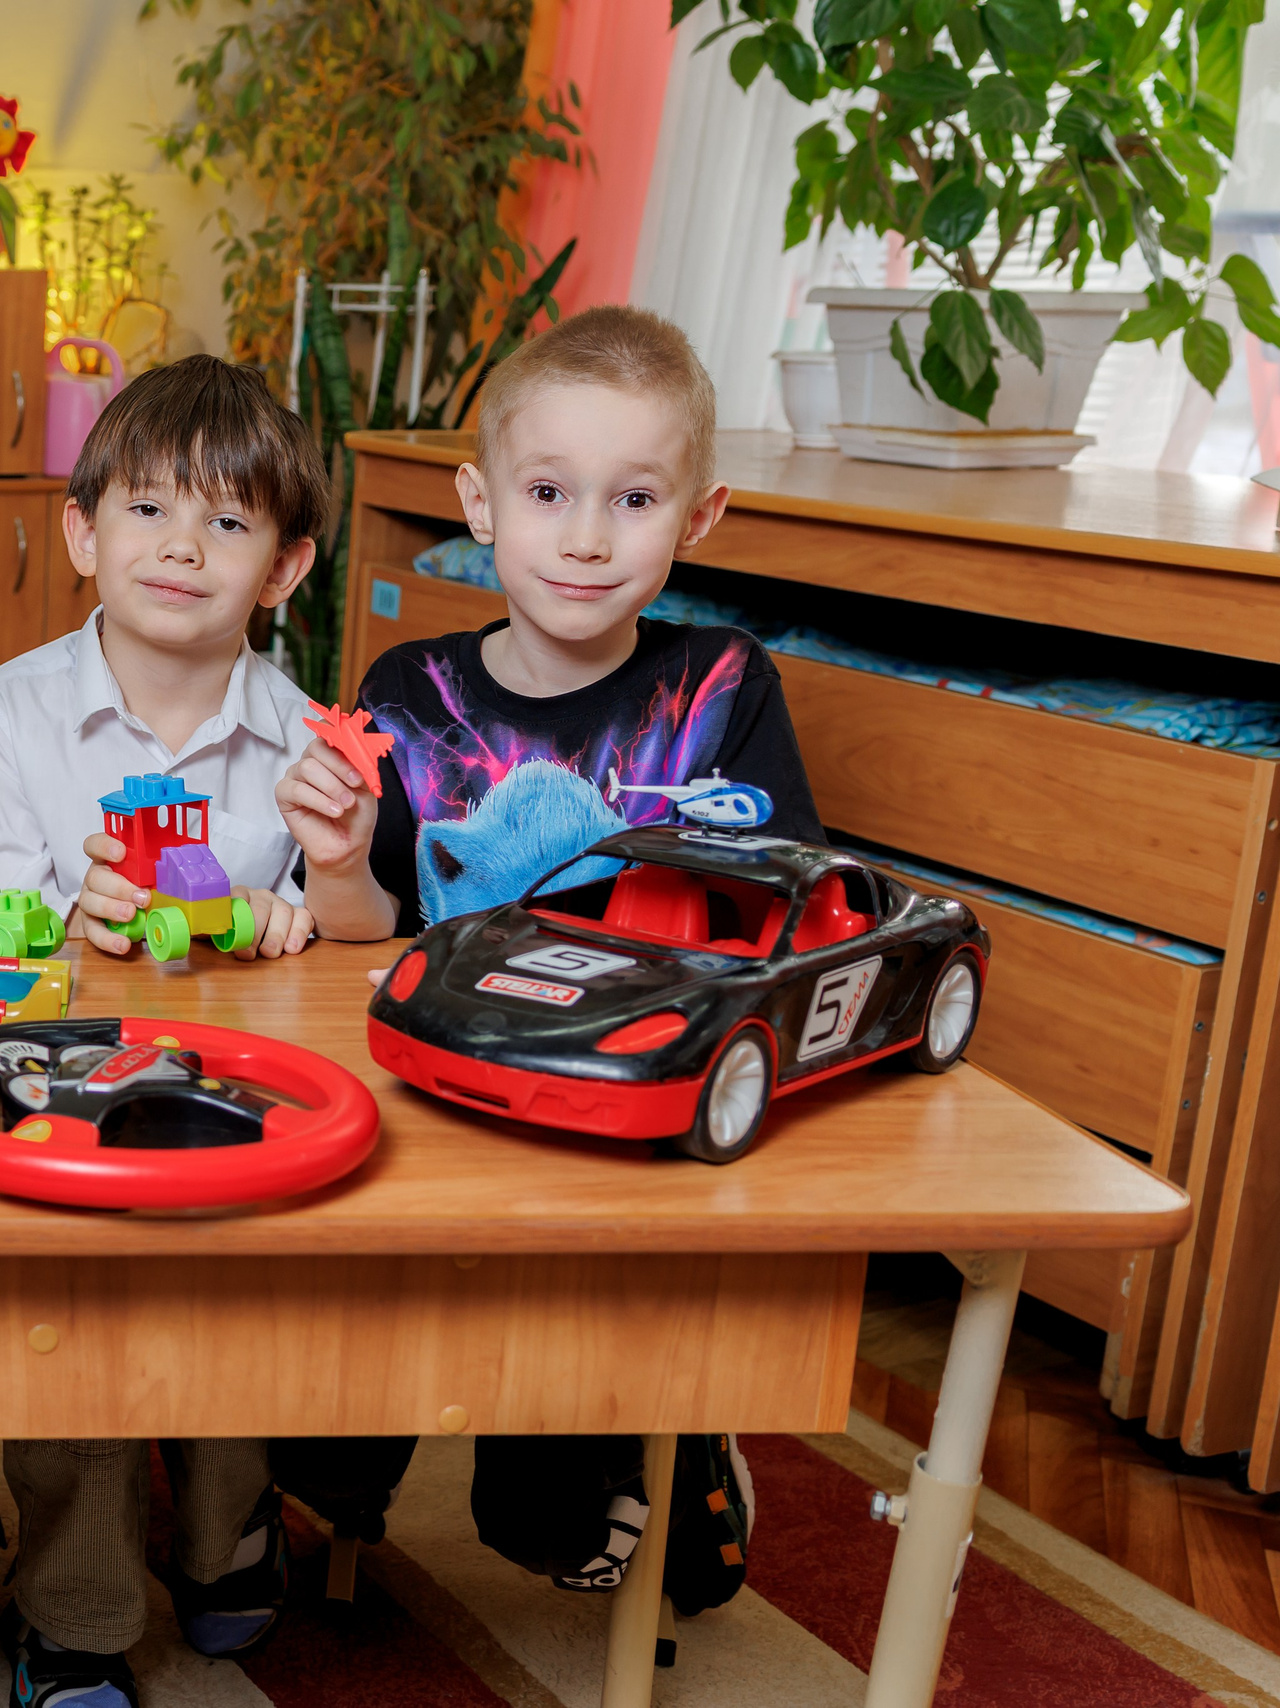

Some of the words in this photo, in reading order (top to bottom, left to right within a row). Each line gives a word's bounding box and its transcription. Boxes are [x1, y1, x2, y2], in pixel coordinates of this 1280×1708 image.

[527, 951, 609, 971] 5
[488, 978, 571, 1001] STELLAR
[807, 975, 850, 1046] 5
